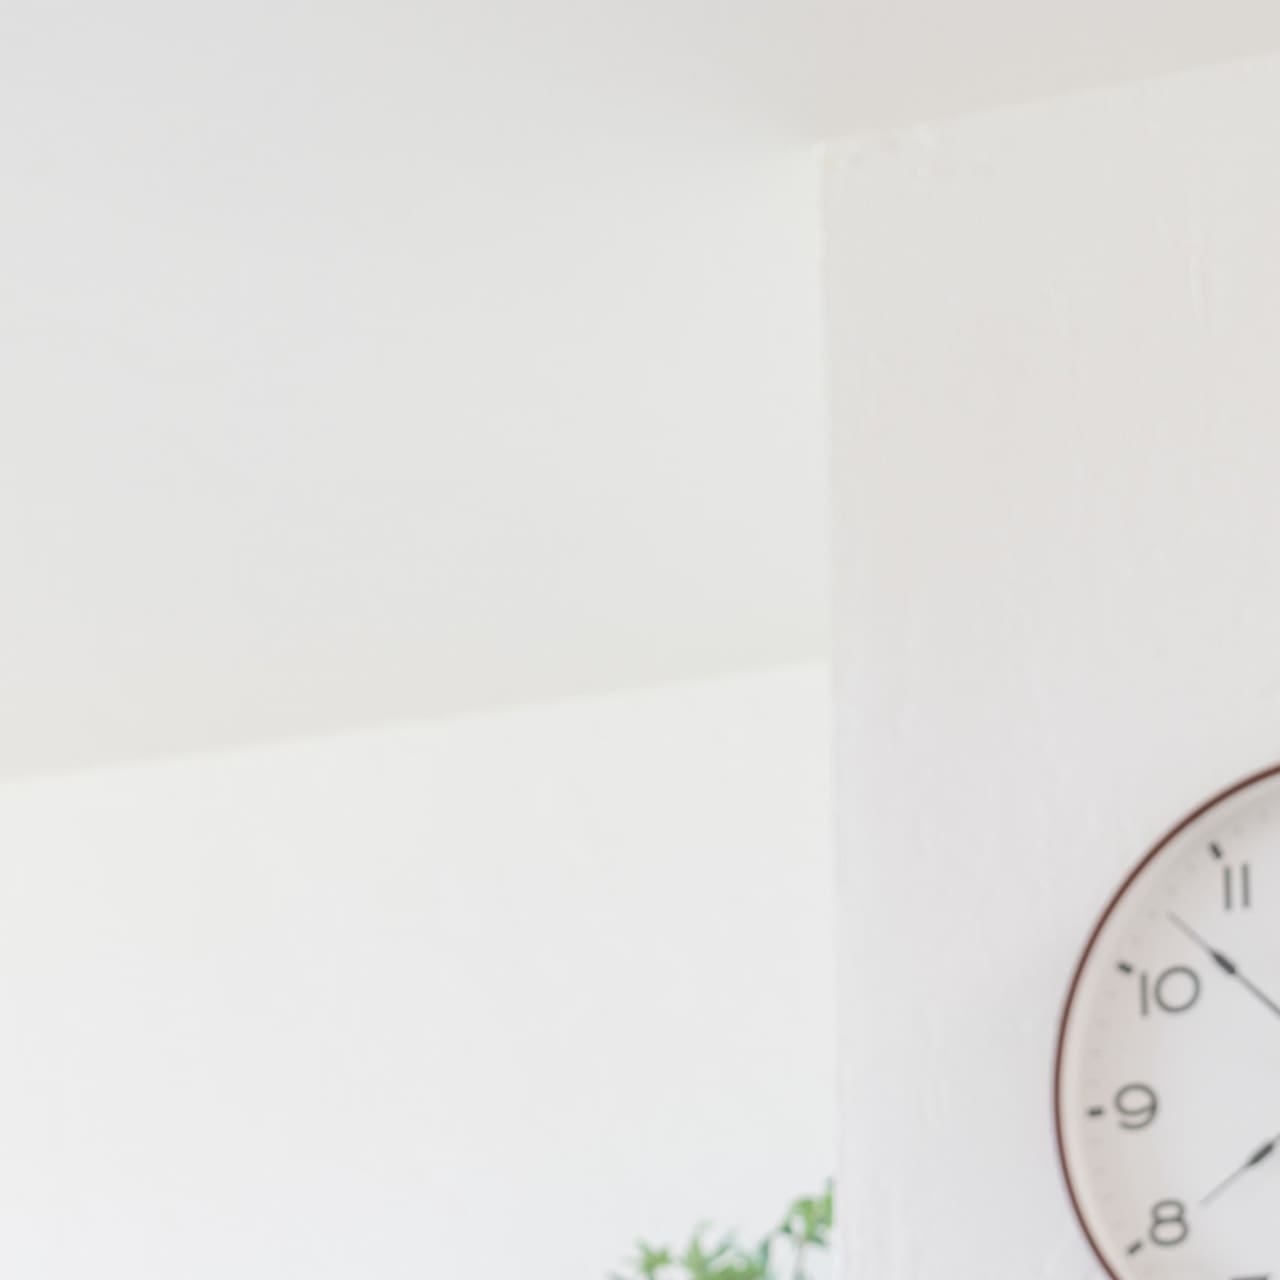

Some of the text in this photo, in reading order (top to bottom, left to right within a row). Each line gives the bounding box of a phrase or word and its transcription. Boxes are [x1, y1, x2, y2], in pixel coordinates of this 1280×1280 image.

[1223, 863, 1251, 911] 11
[1139, 965, 1200, 1016] 10
[1114, 1083, 1158, 1130] 9
[1149, 1200, 1188, 1248] 8
